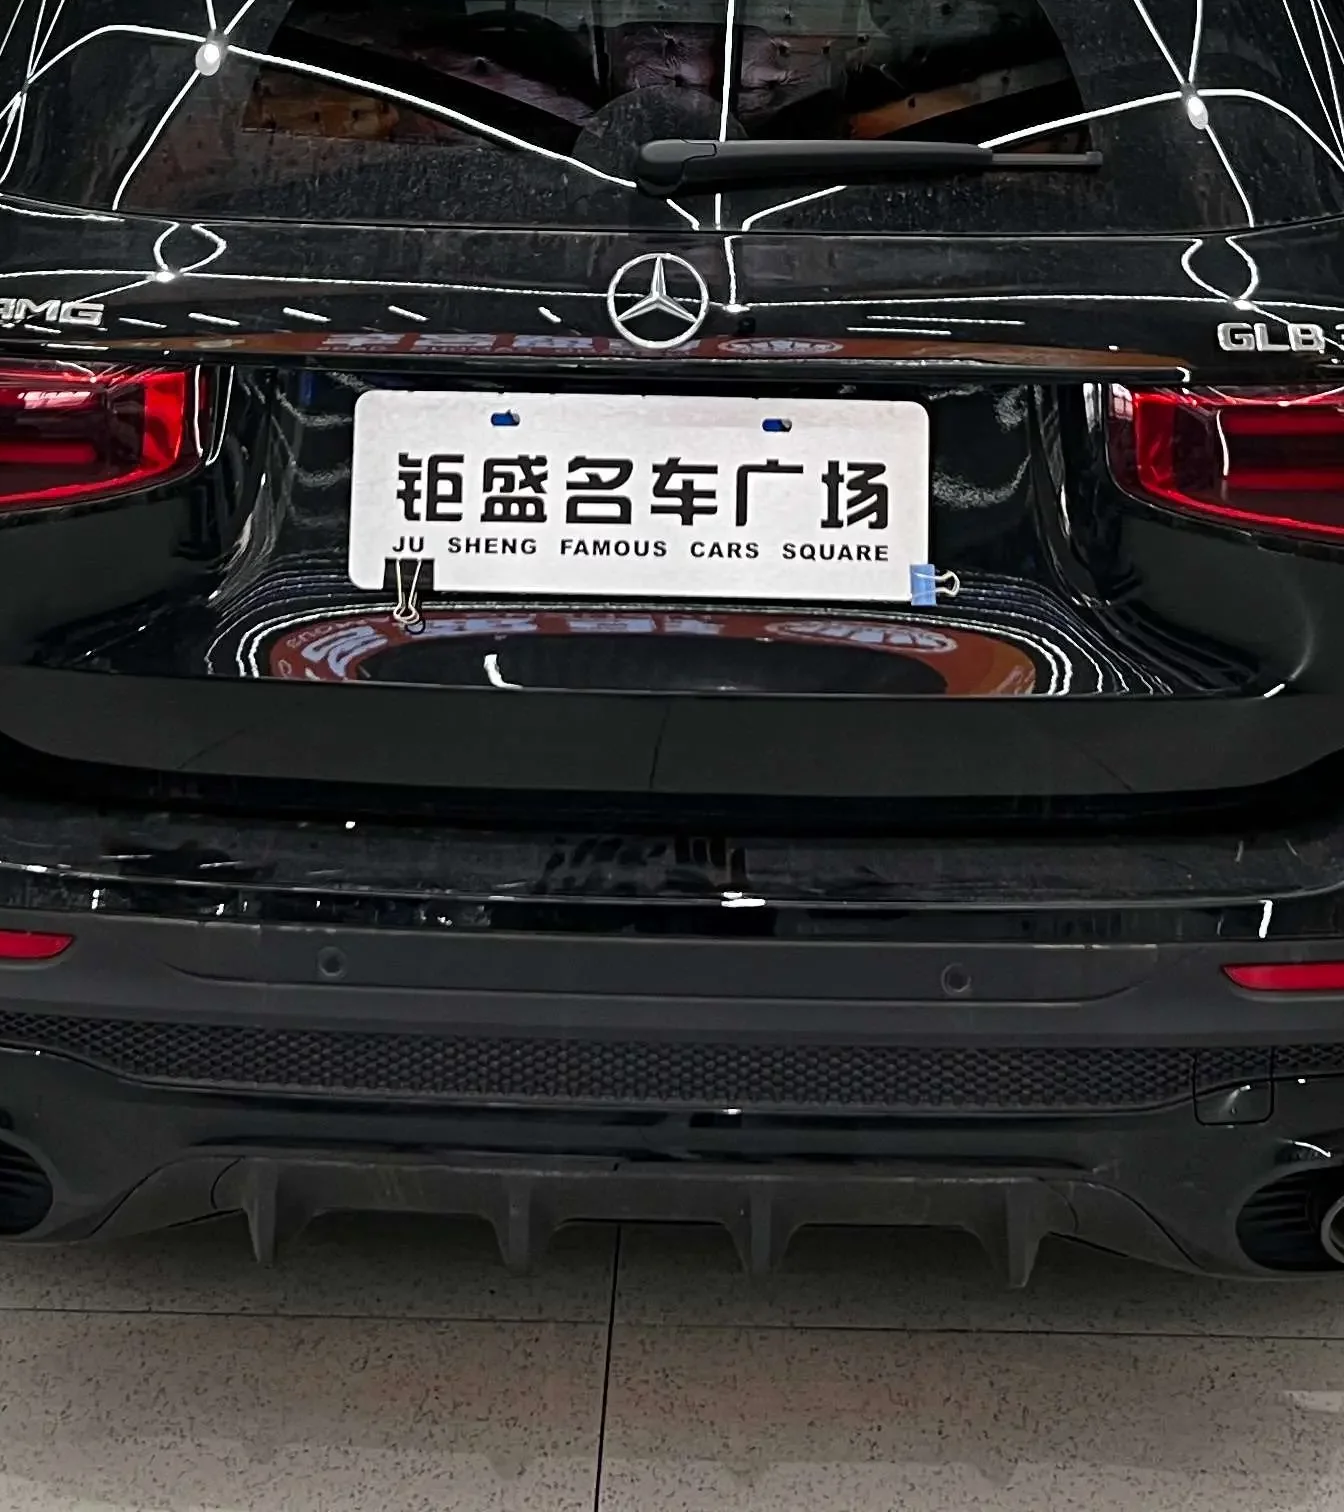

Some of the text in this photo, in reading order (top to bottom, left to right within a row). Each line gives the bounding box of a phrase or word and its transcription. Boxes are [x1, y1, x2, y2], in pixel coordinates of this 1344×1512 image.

[1217, 322, 1326, 352] GLB
[396, 451, 889, 530] 钜盛名车广场
[392, 535, 890, 563] JU SHENG FAMOUS CARS SQUARE
